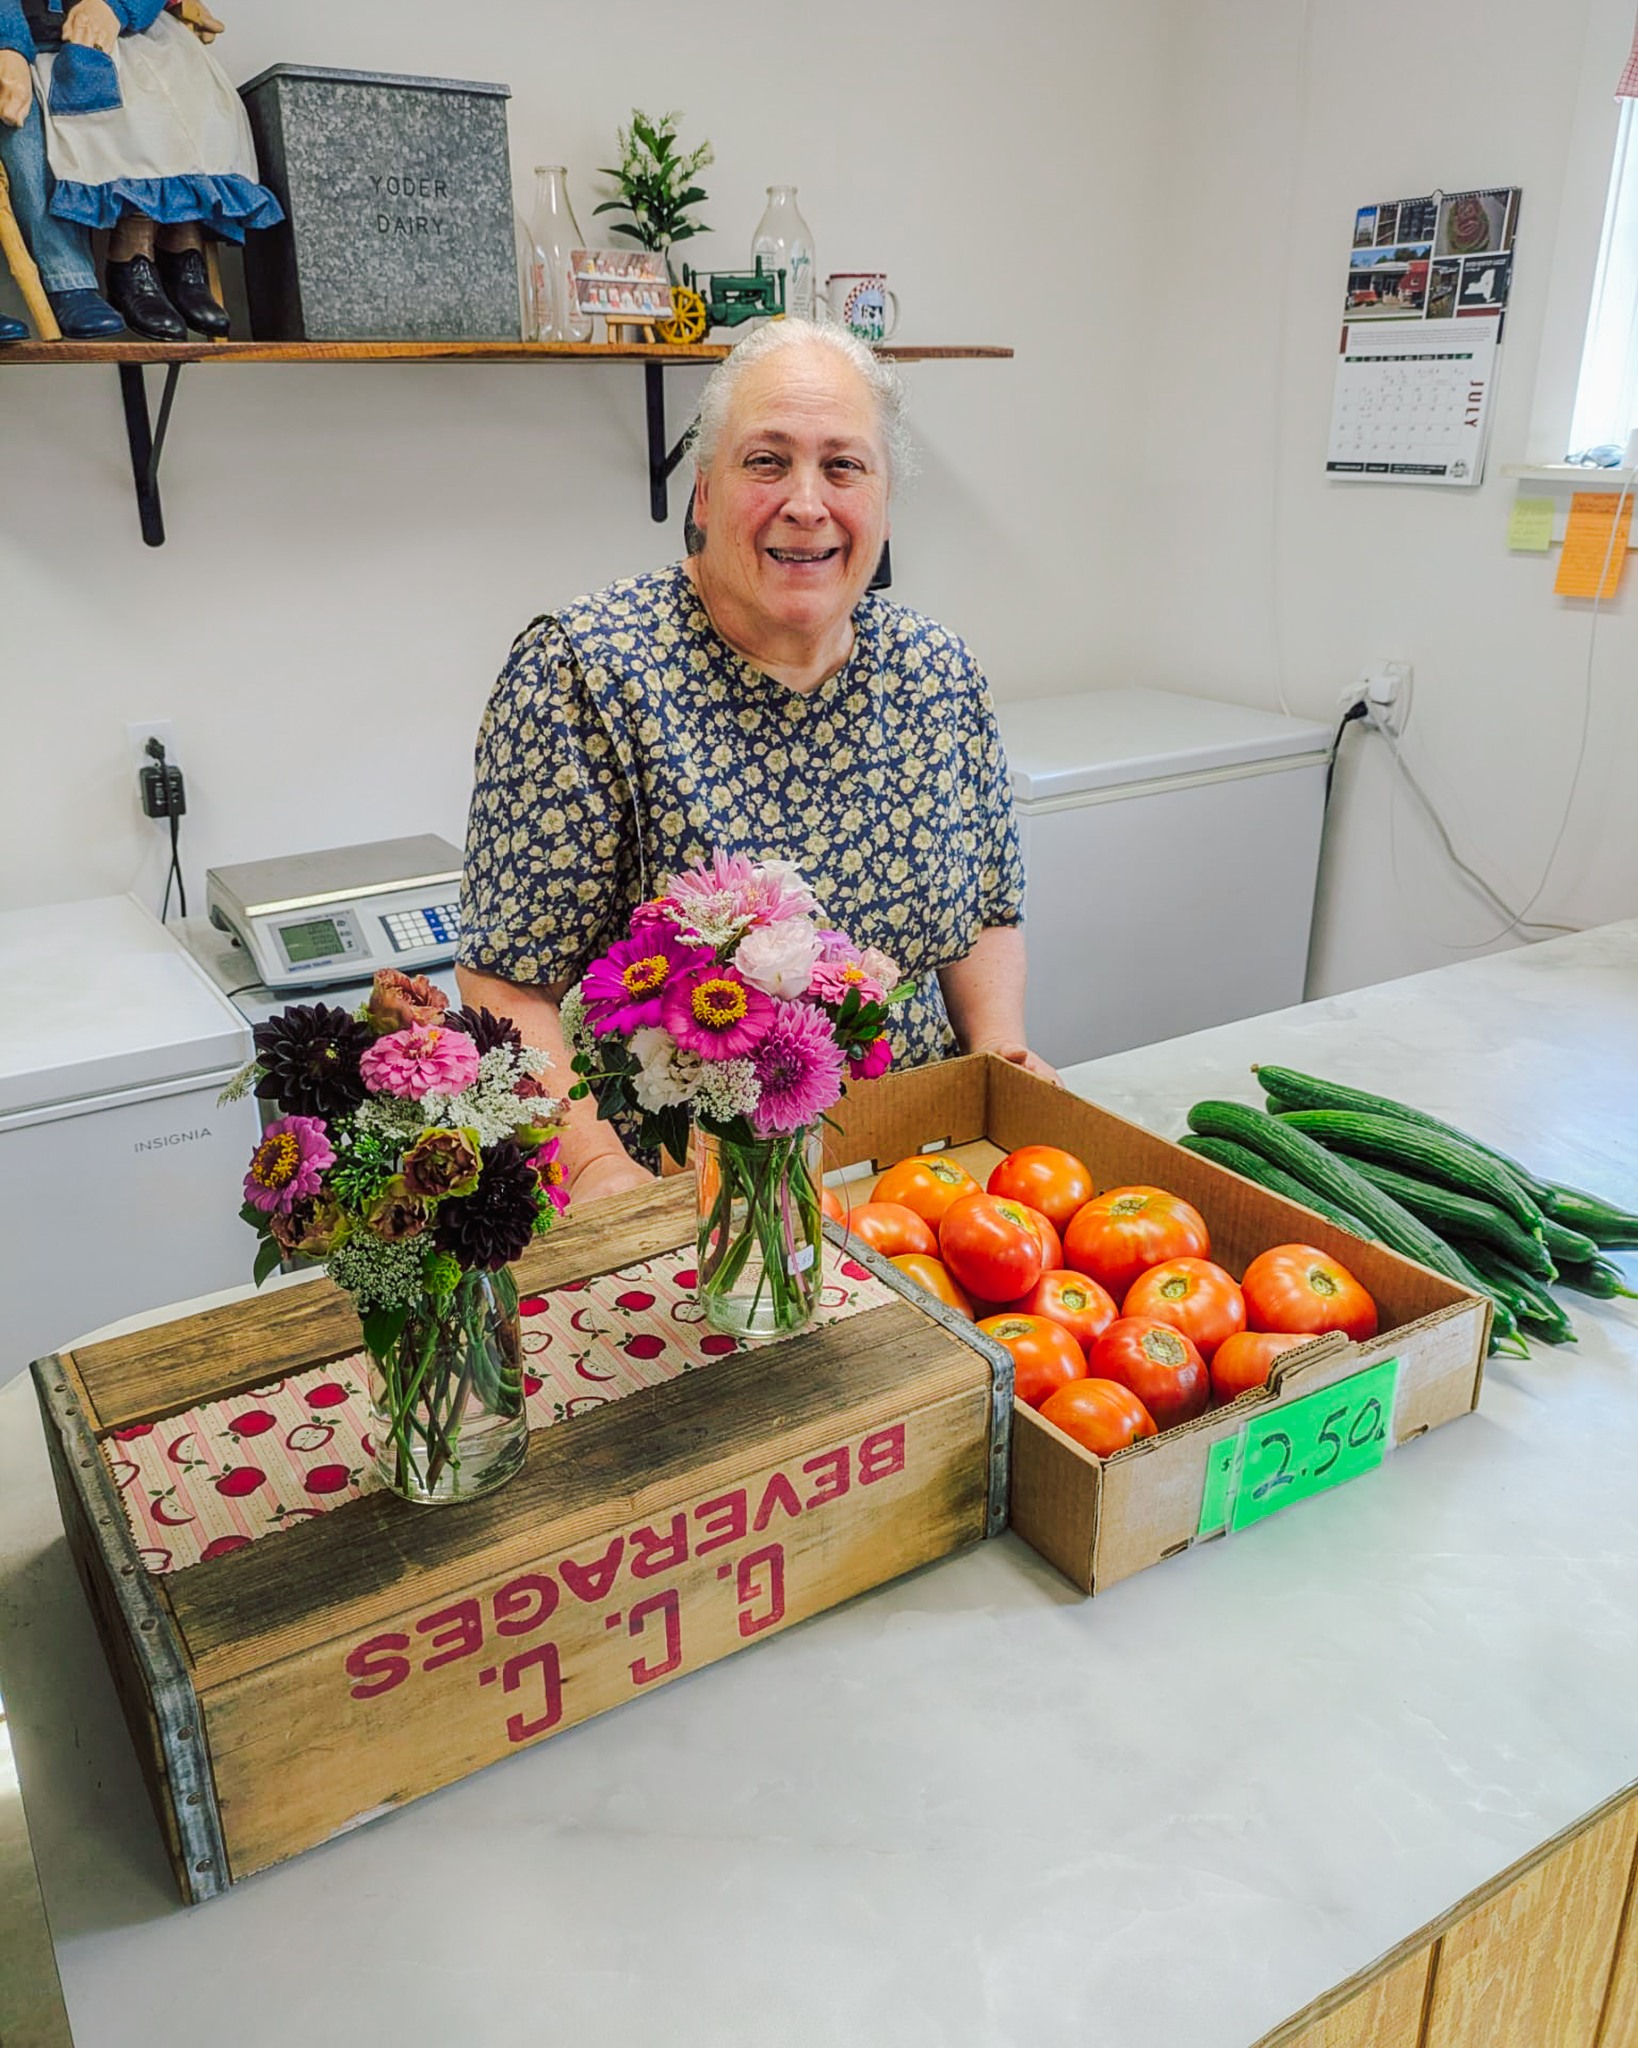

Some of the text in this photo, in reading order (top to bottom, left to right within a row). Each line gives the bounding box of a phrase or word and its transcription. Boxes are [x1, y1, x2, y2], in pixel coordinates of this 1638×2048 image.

[369, 175, 448, 198] YODER
[377, 214, 443, 236] DAIRY
[1464, 380, 1485, 428] JULY
[134, 1127, 213, 1153] INSIGNIA
[345, 1422, 906, 1700] BEVERAGES
[479, 1541, 785, 1743] G. C. C.
